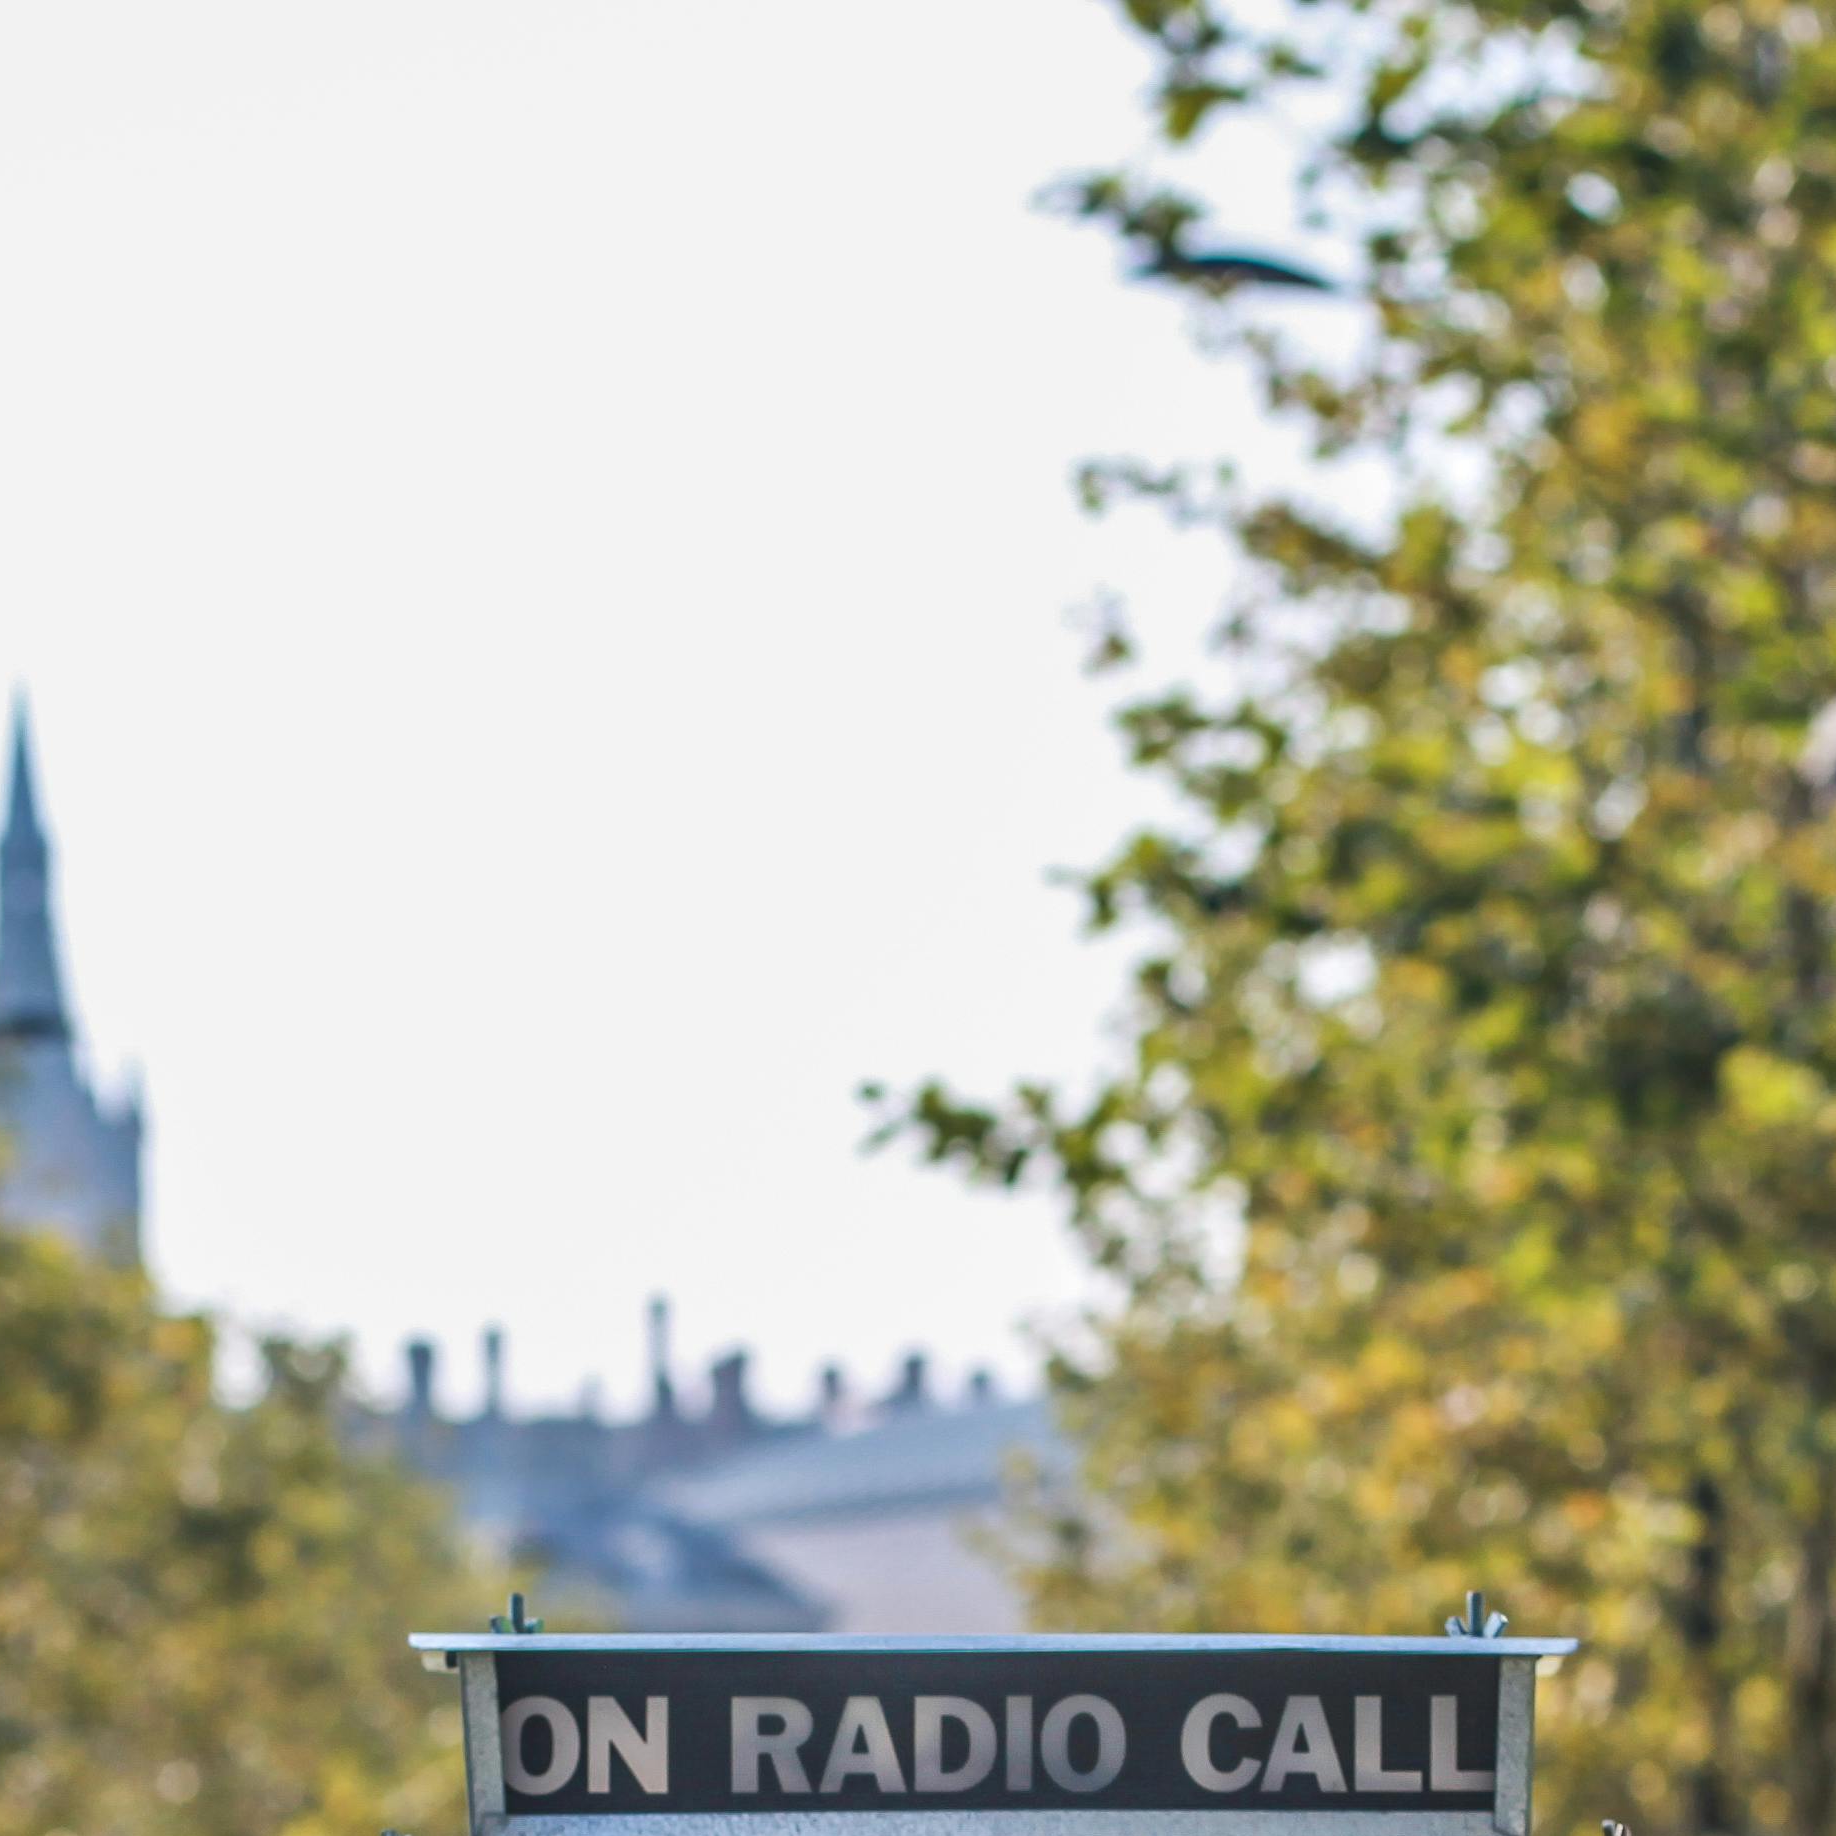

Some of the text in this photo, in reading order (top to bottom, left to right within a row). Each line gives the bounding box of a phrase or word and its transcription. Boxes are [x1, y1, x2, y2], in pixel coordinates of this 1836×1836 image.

[500, 1693, 1495, 1796] ON RADIO CALL
